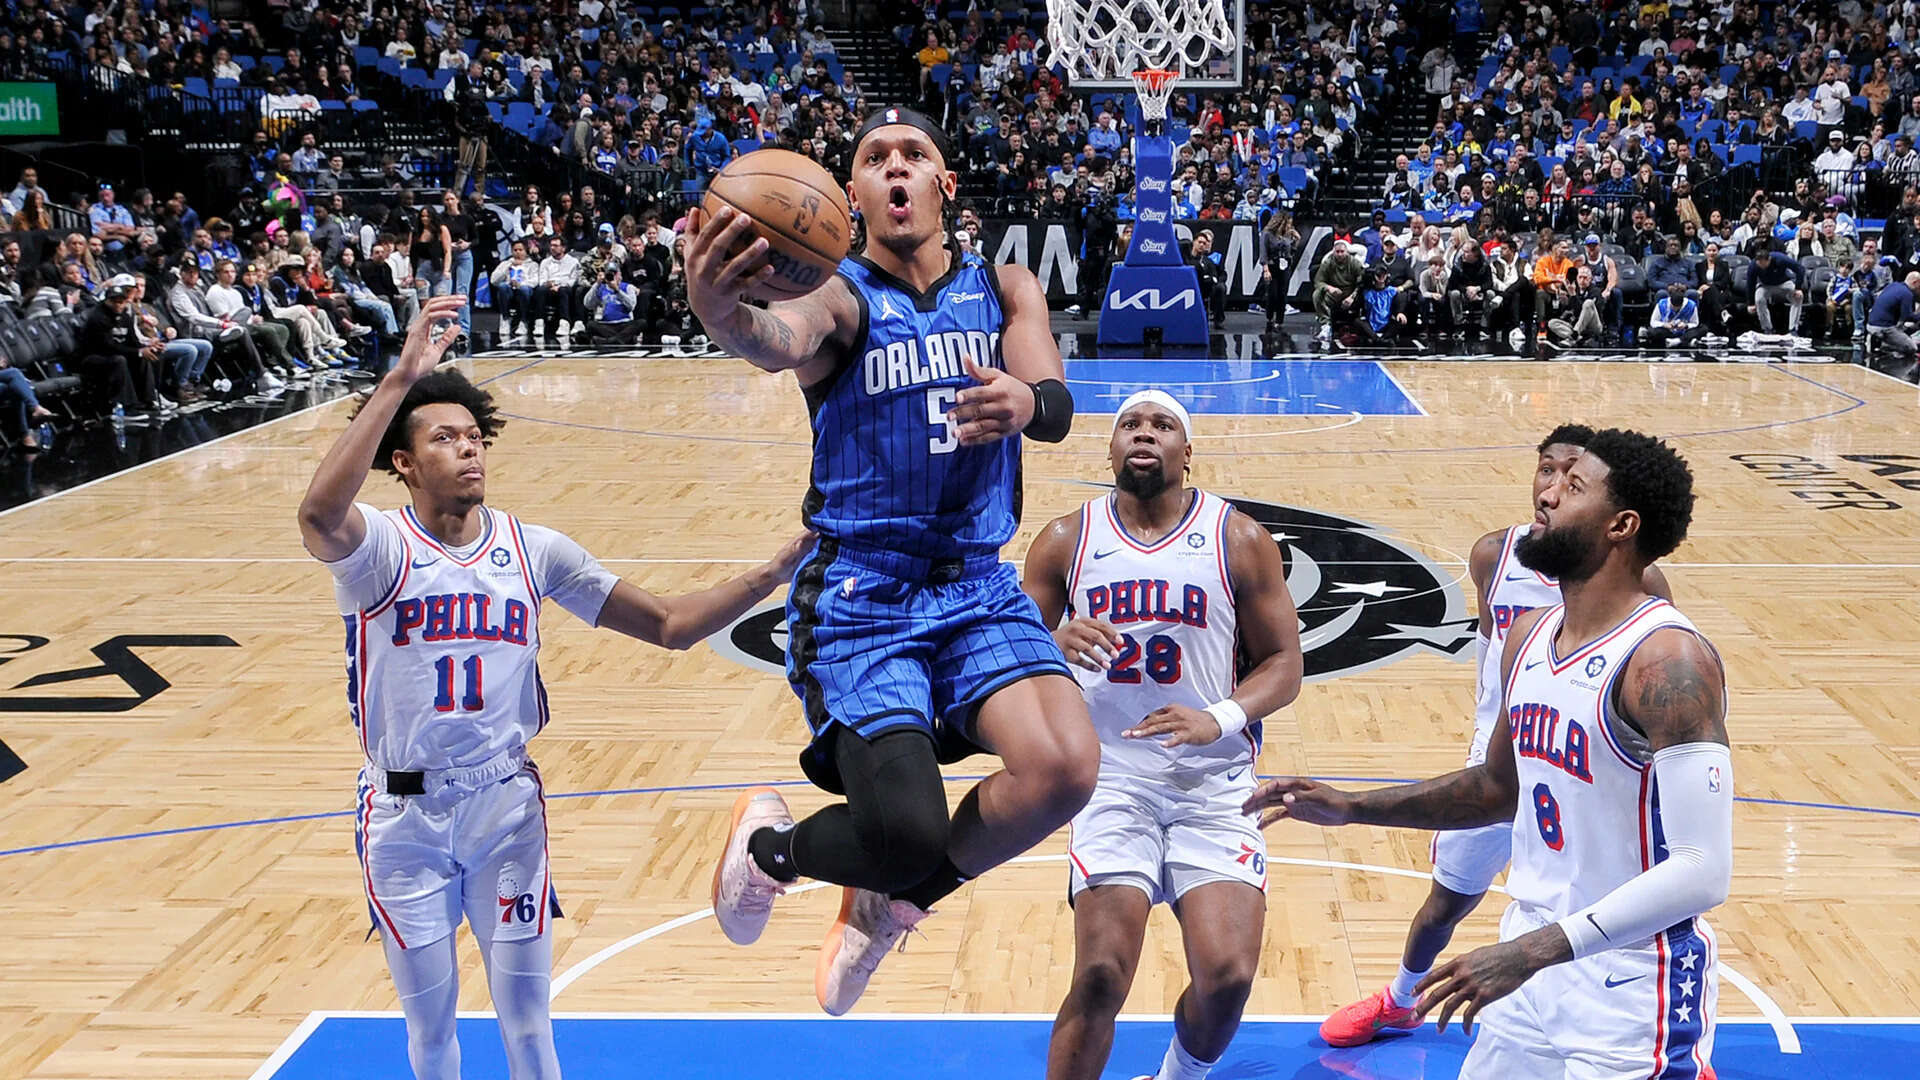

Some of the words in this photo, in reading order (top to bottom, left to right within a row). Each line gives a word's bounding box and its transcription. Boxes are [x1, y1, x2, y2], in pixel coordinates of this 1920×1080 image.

[947, 291, 985, 304] Disney
[1110, 288, 1195, 310] KIA
[927, 387, 959, 455] 5
[1729, 453, 1904, 511] CENTER
[392, 592, 529, 647] PHILA
[1086, 578, 1208, 629] PHILA
[433, 655, 484, 712] 11
[1107, 632, 1182, 684] 28
[1509, 702, 1594, 784] PHILA
[1532, 782, 1565, 852] 8
[1236, 842, 1265, 876] 76
[498, 892, 536, 924] 76
